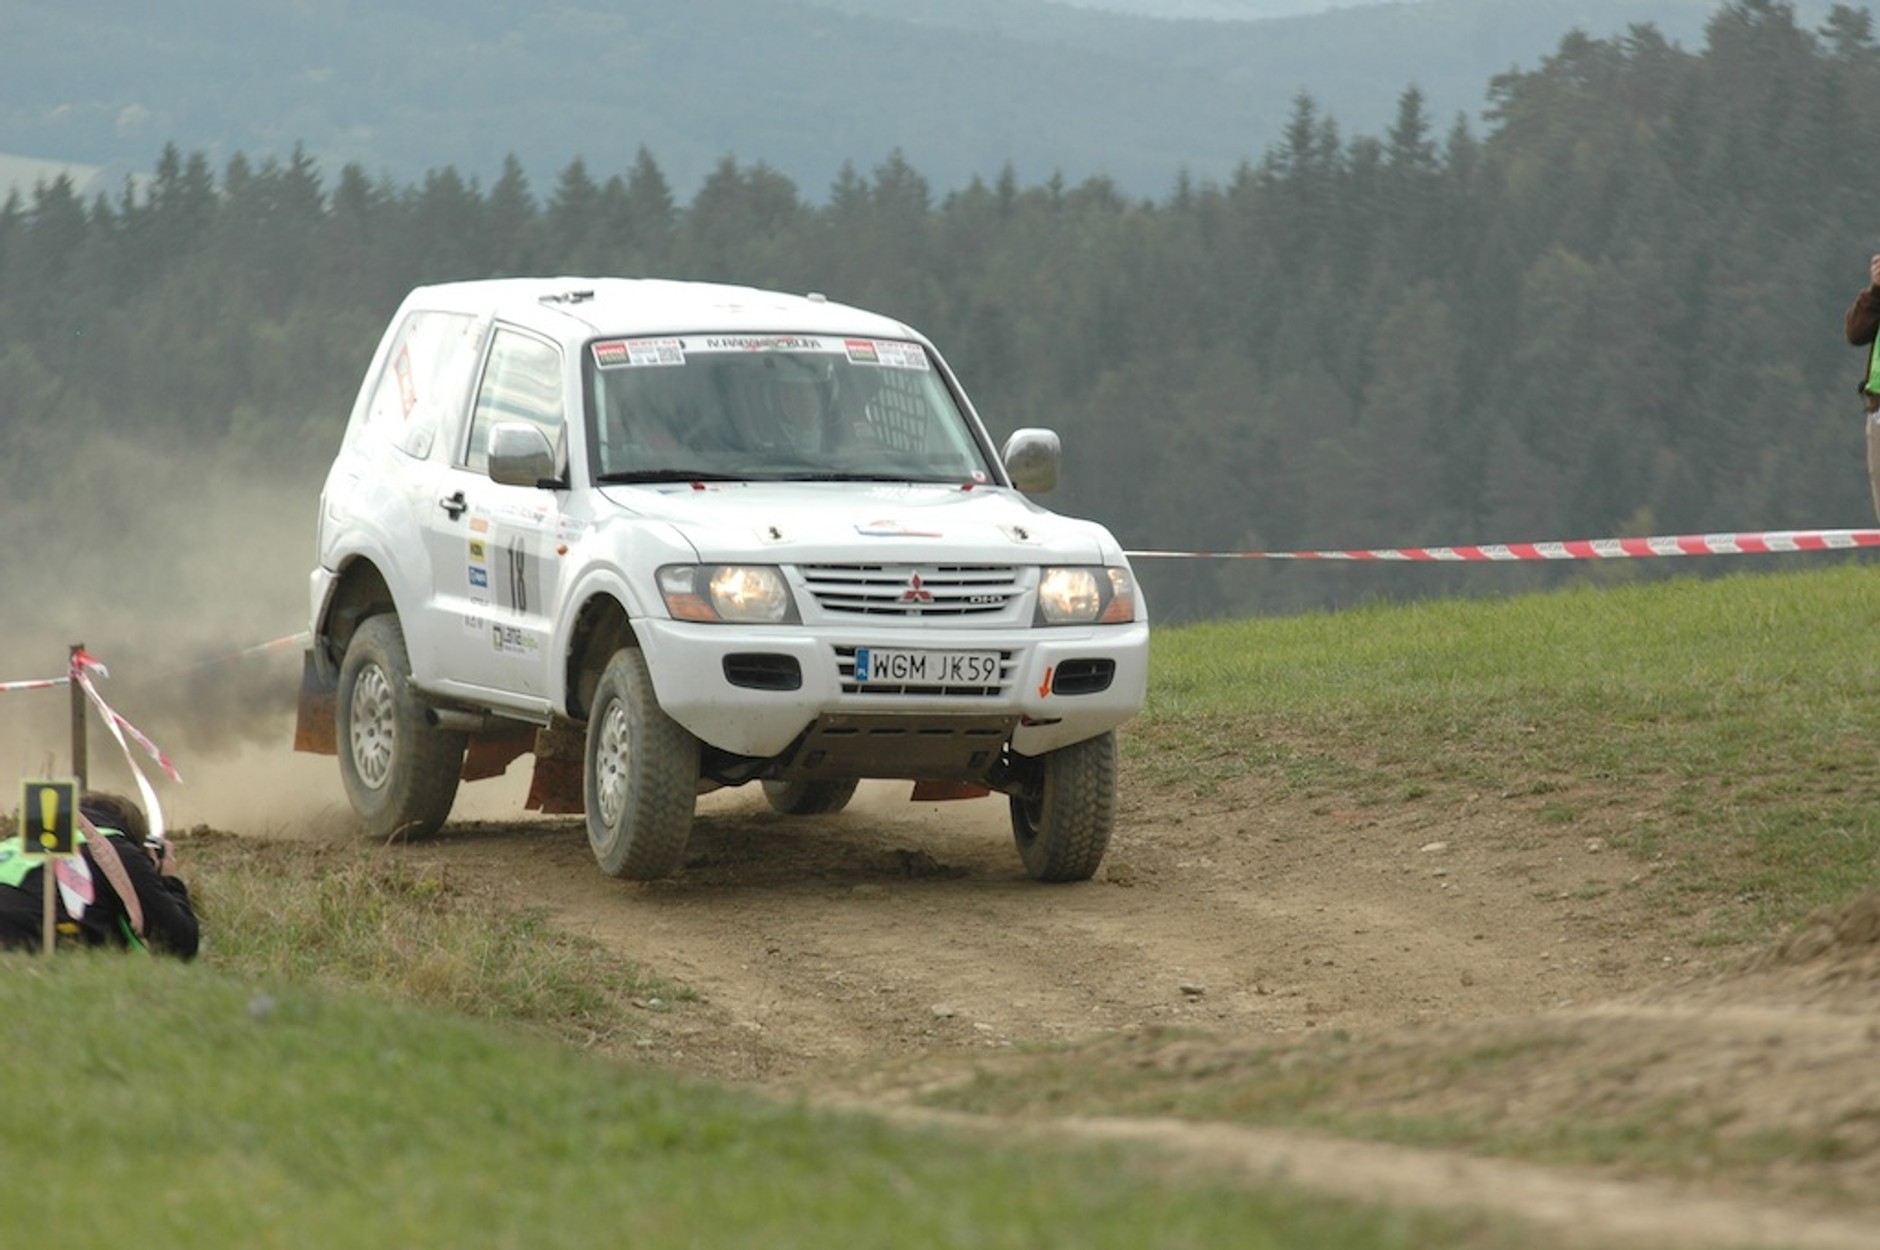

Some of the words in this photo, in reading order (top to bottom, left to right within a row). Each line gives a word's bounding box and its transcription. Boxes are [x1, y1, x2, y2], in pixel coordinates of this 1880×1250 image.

[507, 535, 527, 616] 18
[873, 654, 926, 679] WGM
[938, 655, 995, 681] JK59
